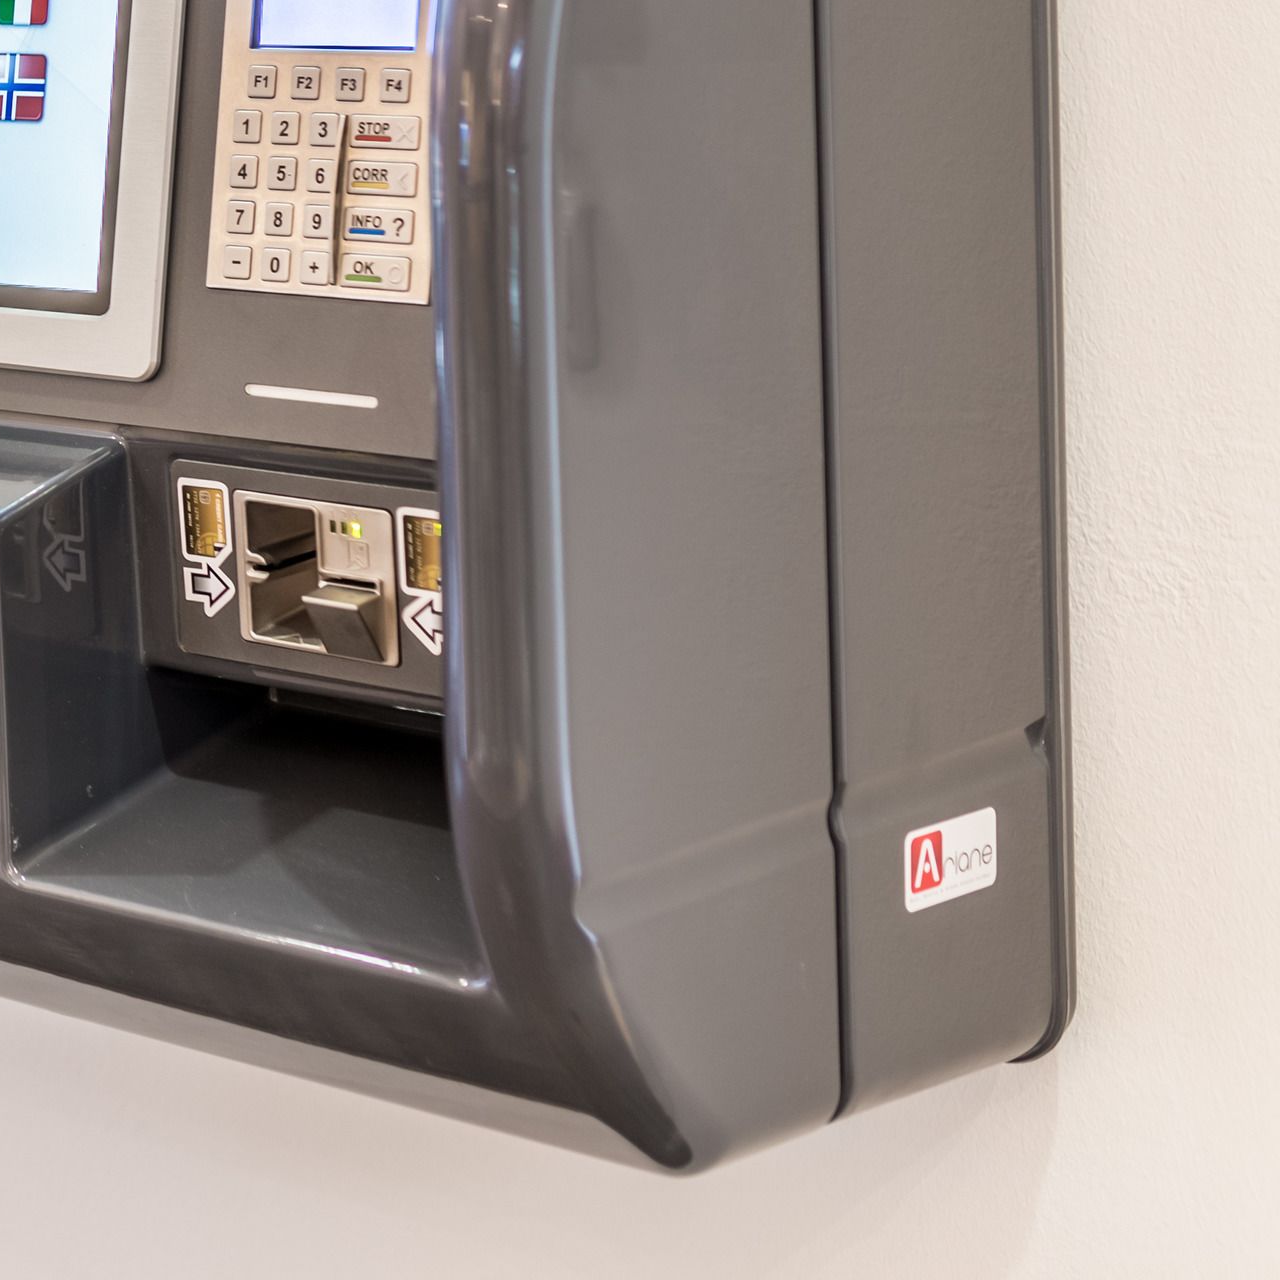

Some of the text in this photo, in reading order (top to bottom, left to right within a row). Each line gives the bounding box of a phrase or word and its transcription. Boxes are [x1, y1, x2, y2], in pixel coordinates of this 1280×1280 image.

[254, 75, 269, 88] F1
[296, 76, 313, 89] F2
[340, 78, 357, 92] F3
[385, 78, 403, 93] F4
[242, 118, 249, 135] 1
[279, 120, 289, 137] 2
[318, 121, 328, 138] 3
[358, 122, 390, 135] STOP
[237, 164, 247, 180] 4
[276, 166, 286, 181] 5
[315, 168, 325, 184] 6
[353, 168, 388, 182] CORR
[235, 209, 244, 225] 7
[273, 211, 283, 228] 8
[312, 213, 322, 230] 9
[351, 214, 382, 228] INFO
[270, 257, 280, 273] 0
[353, 261, 374, 274] OK
[914, 837, 993, 888] Ariane
